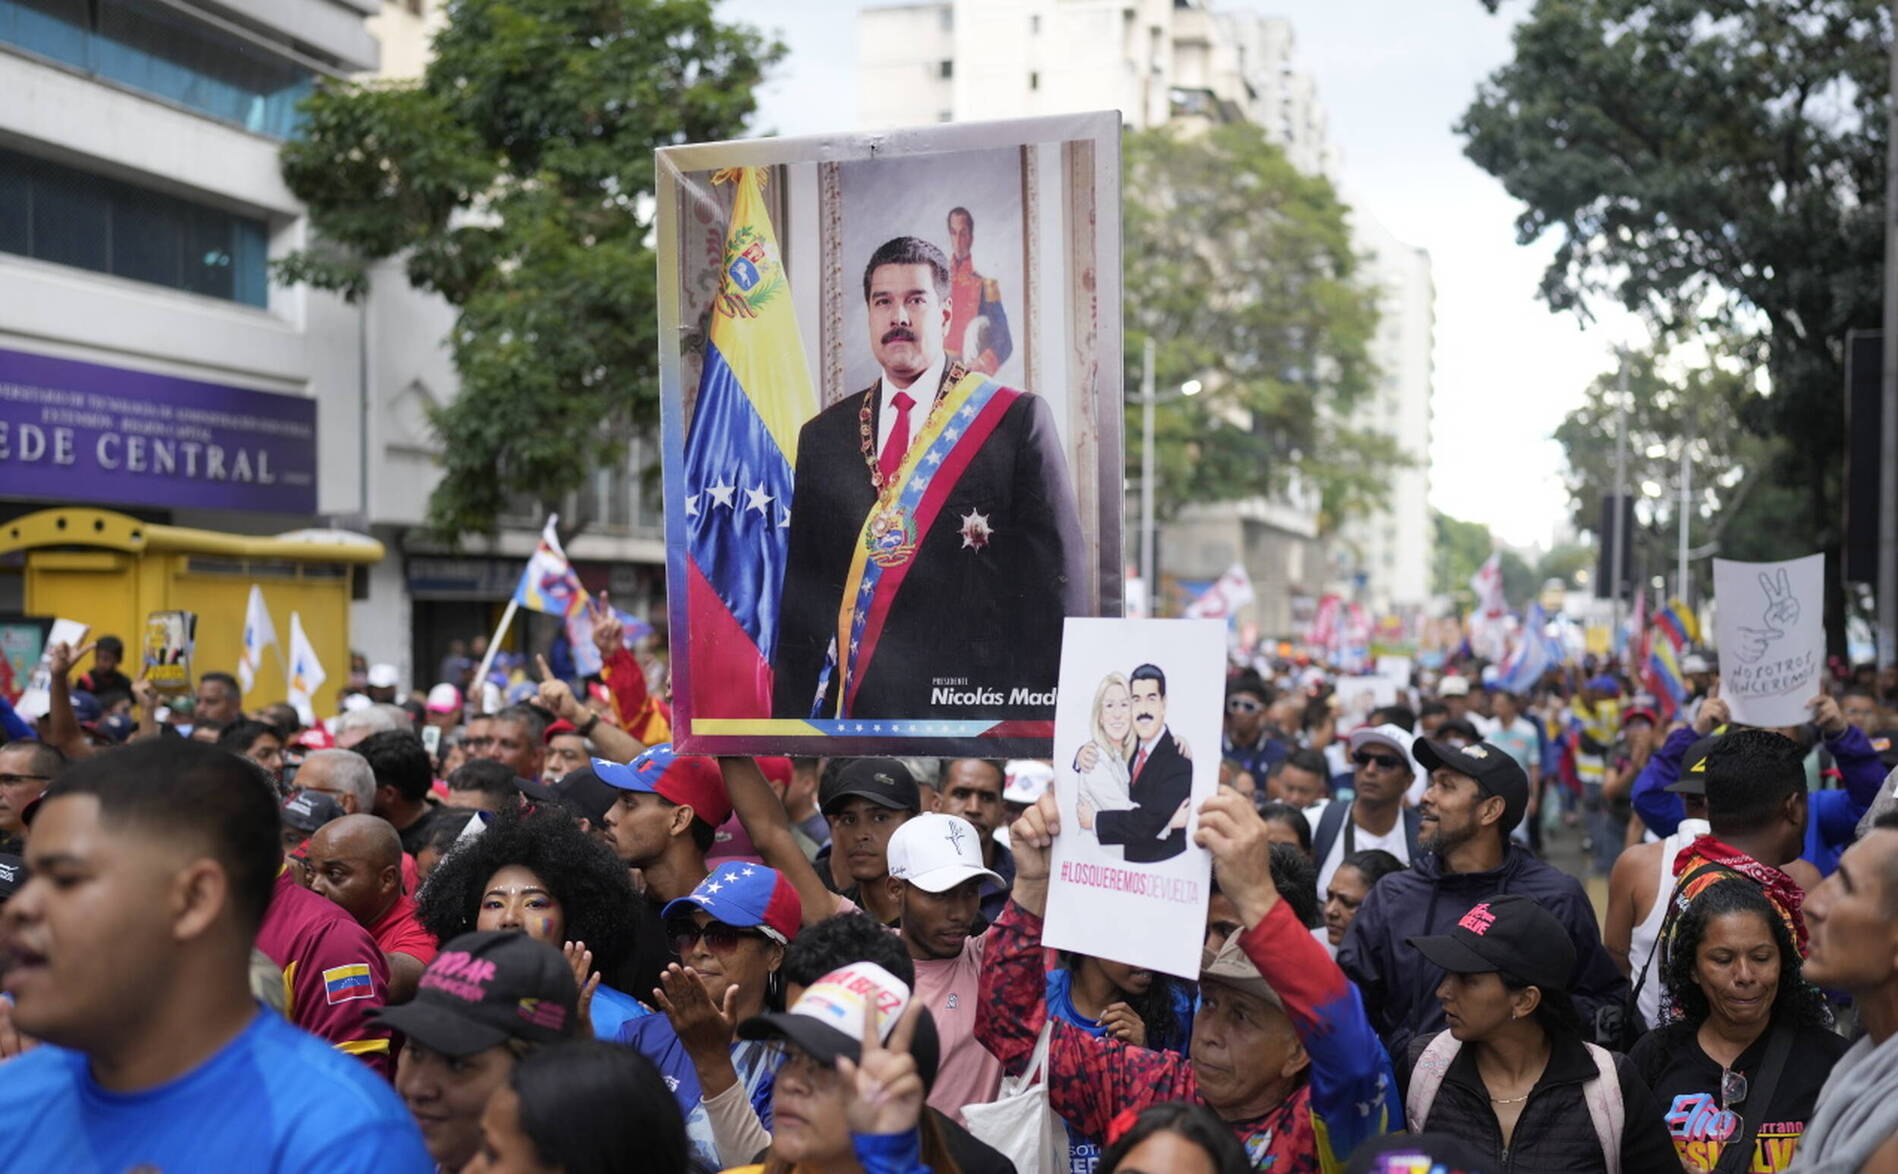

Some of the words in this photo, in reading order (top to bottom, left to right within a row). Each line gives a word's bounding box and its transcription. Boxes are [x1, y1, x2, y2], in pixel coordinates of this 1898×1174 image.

[96, 432, 276, 485] CENTRAL
[932, 677, 968, 686] PRESIDENTE
[931, 687, 1004, 705] Nicolás
[1008, 687, 1058, 705] Mad
[1060, 860, 1200, 905] #LOSQUEREMOSDEVUELTA
[1757, 1121, 1804, 1134] rrano
